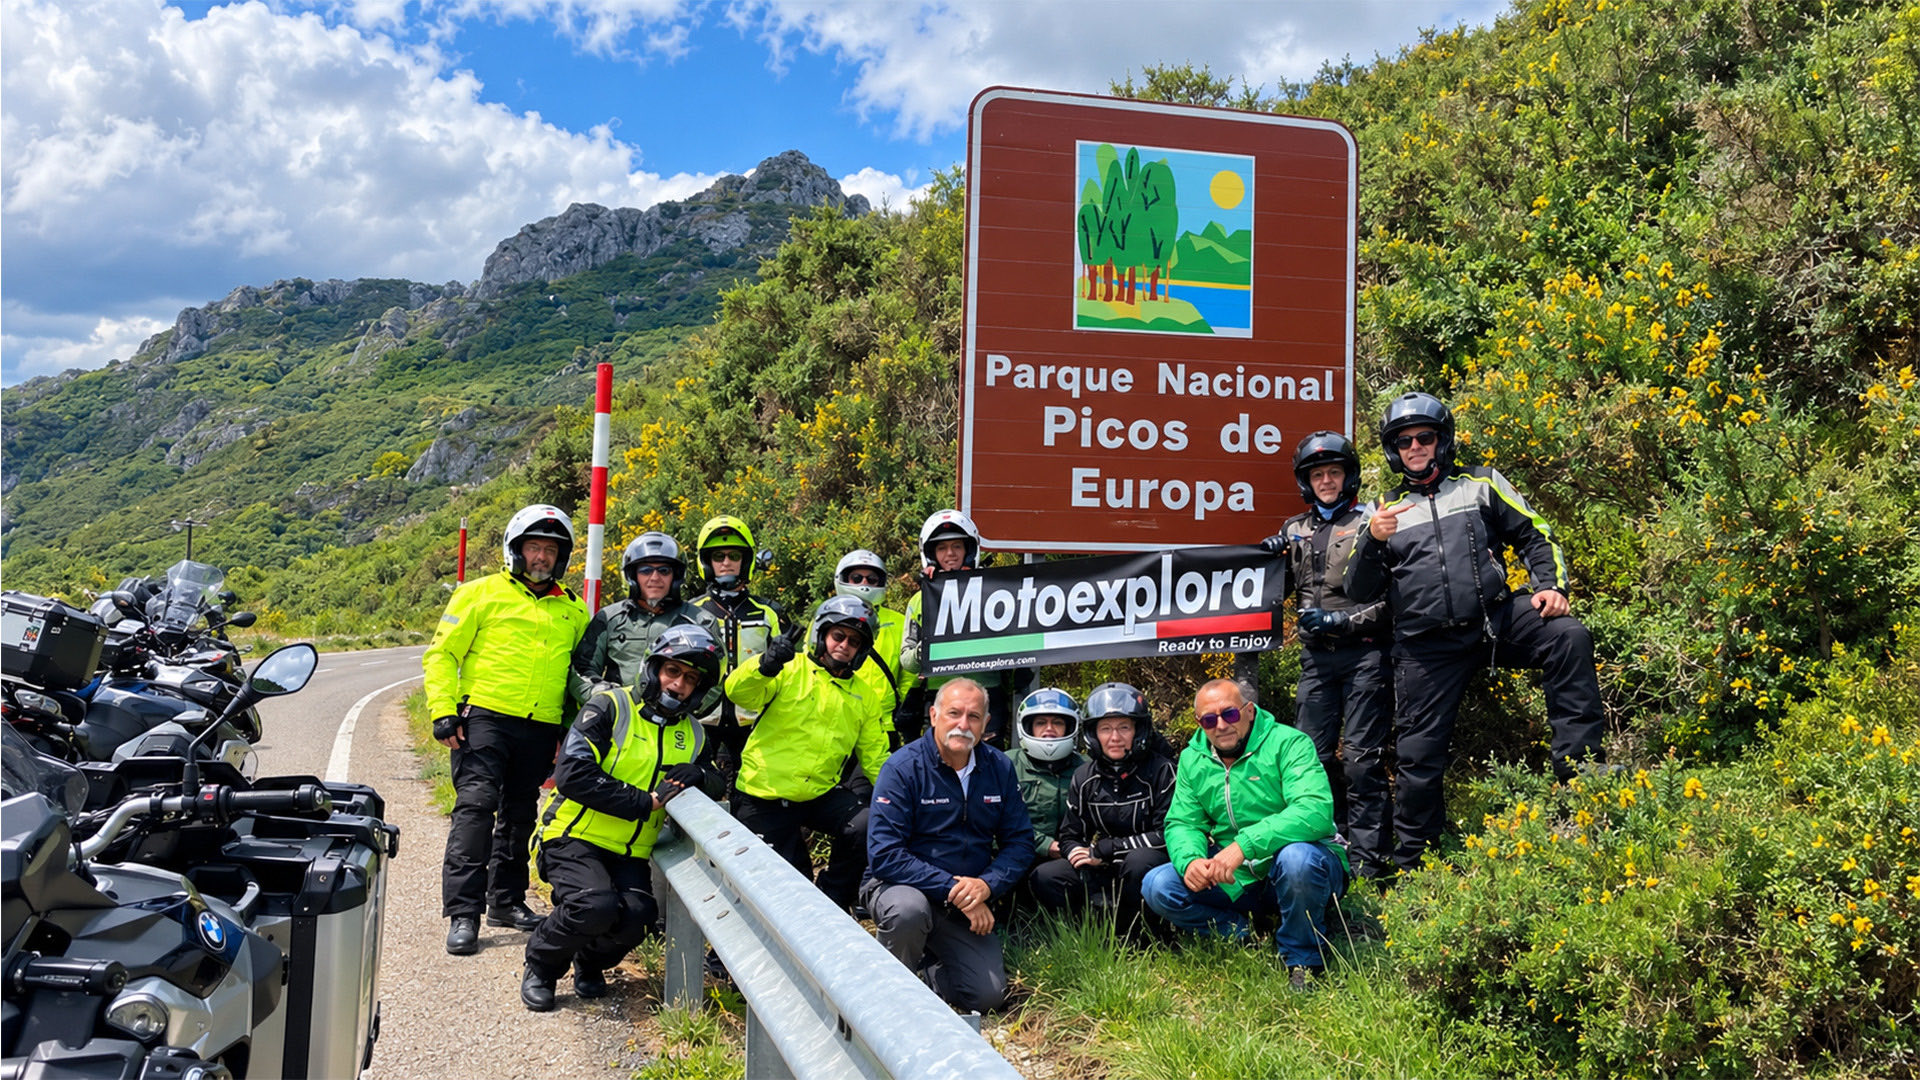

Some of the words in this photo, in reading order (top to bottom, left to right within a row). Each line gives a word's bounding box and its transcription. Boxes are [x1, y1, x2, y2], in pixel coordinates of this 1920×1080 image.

[986, 353, 1134, 399] Parque
[1158, 362, 1335, 402] Nacional
[1043, 405, 1189, 451] Picos
[1220, 412, 1282, 454] de
[1071, 467, 1256, 521] Europa
[933, 553, 1267, 636] Motoexplora
[931, 656, 1037, 673] www.motoexplora.com
[1158, 638, 1205, 653] Ready
[1209, 637, 1225, 650] to
[1229, 634, 1272, 650] Enjoy
